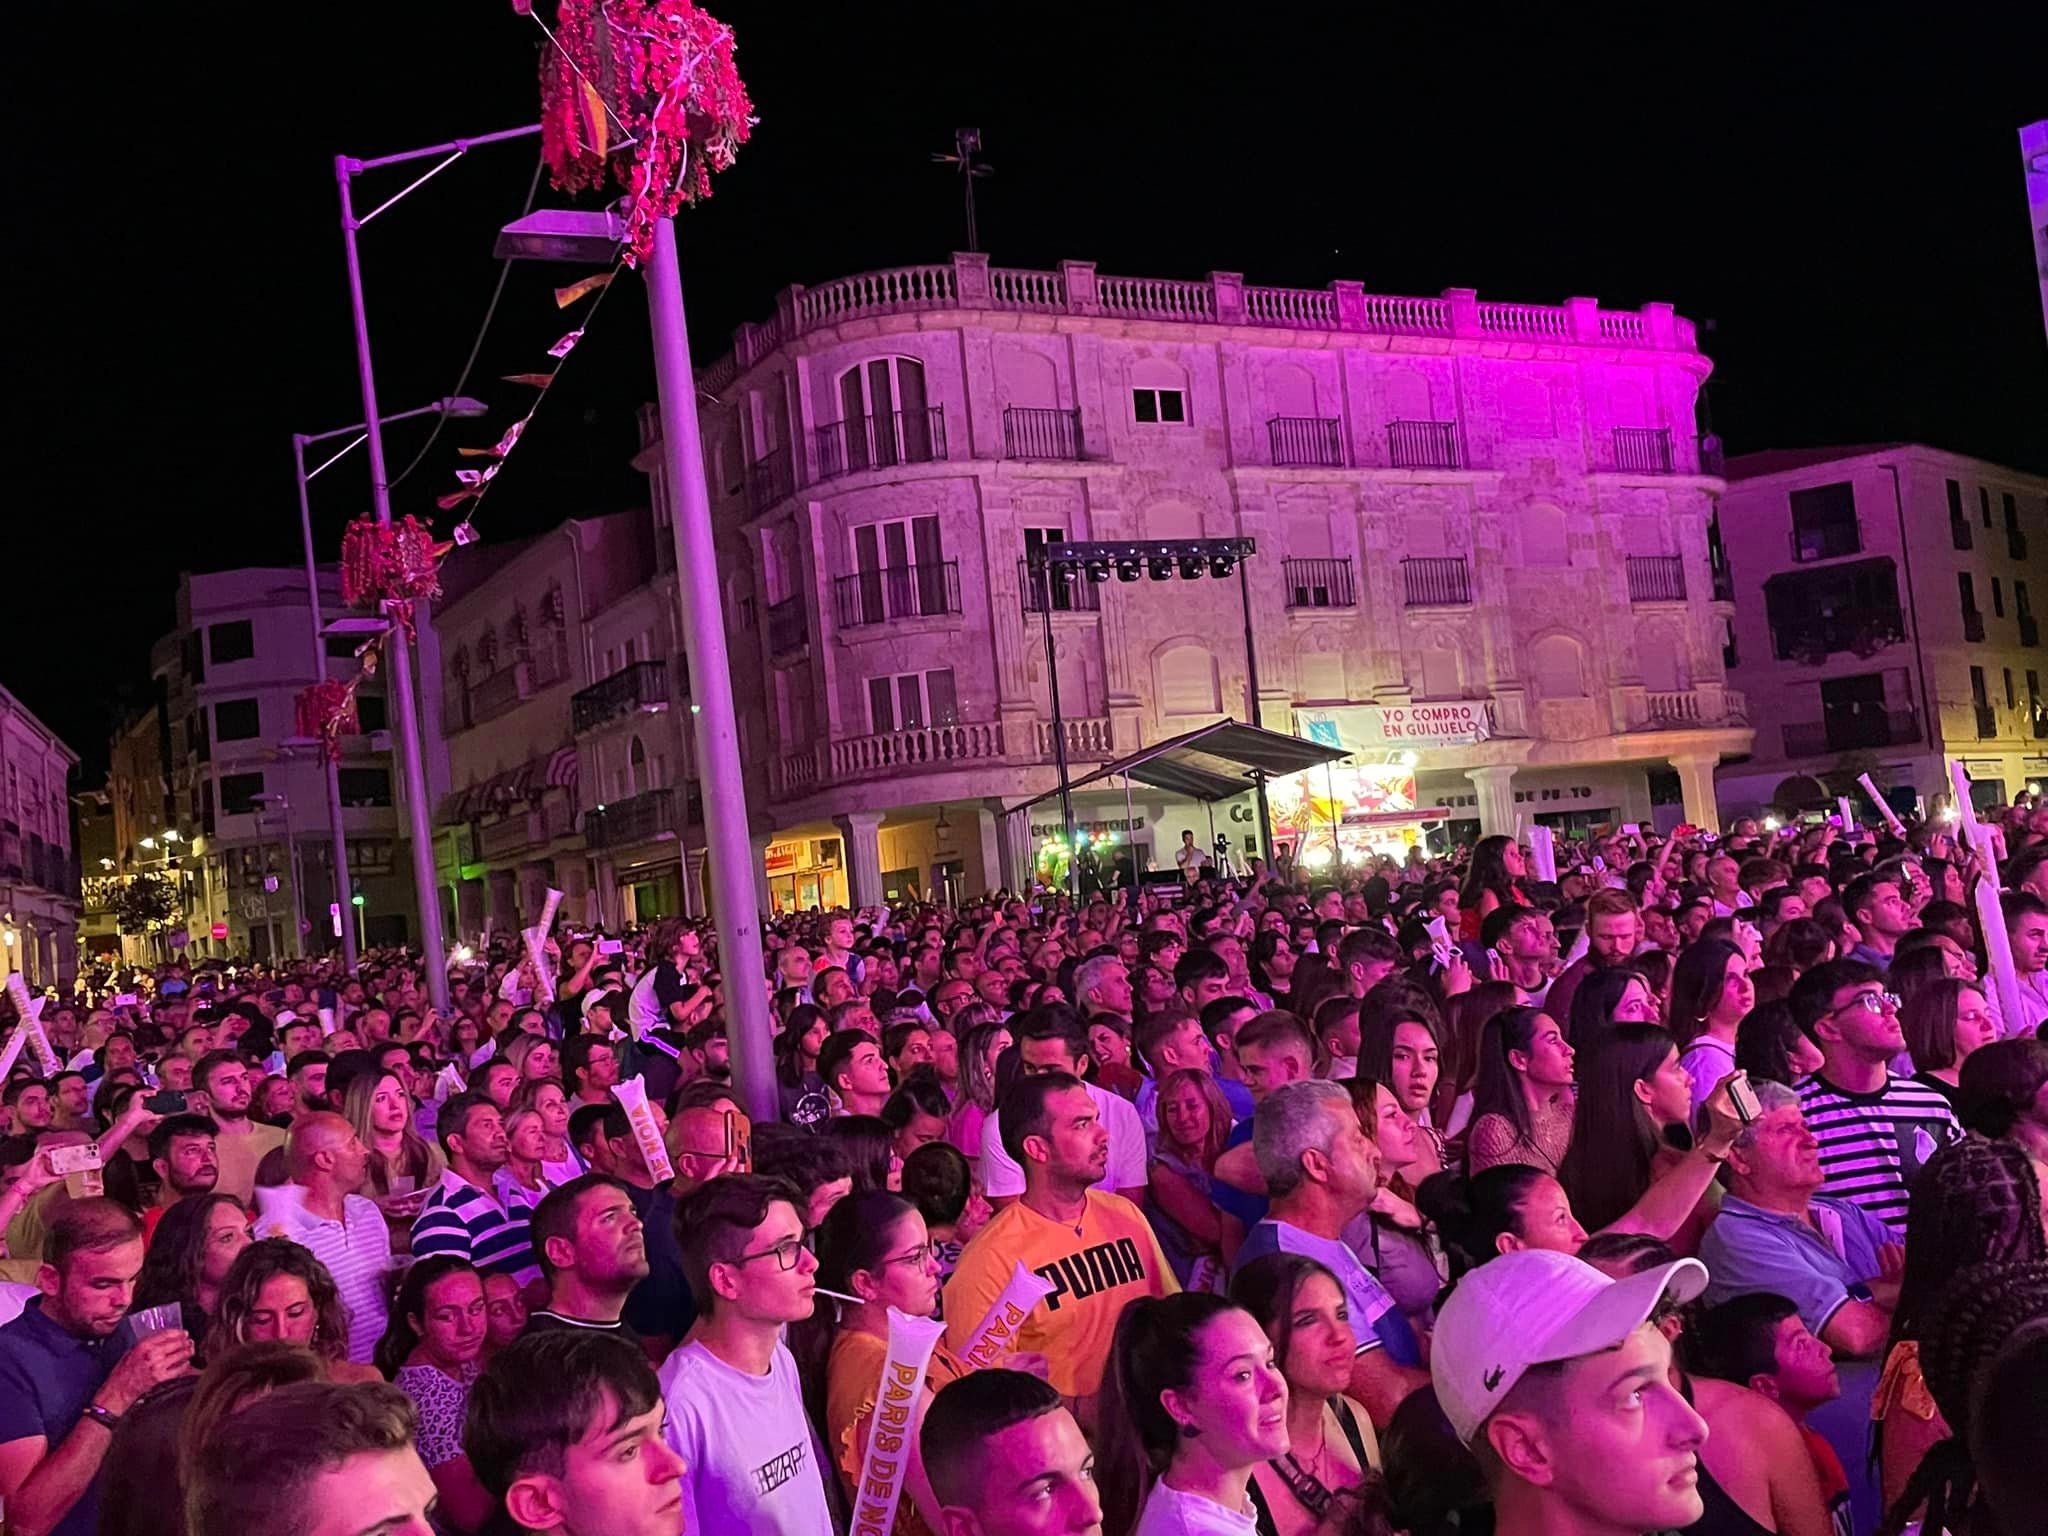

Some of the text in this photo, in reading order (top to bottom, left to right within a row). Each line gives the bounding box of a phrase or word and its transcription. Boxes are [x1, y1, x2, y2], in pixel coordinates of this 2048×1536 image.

[1383, 706, 1471, 723] YO COMPRO
[1383, 720, 1479, 737] EN GUIJUELO
[1033, 1237, 1146, 1312] PUMA
[965, 1300, 1025, 1369] PARI
[874, 1359, 918, 1454] PARIS
[865, 1454, 899, 1499] DE
